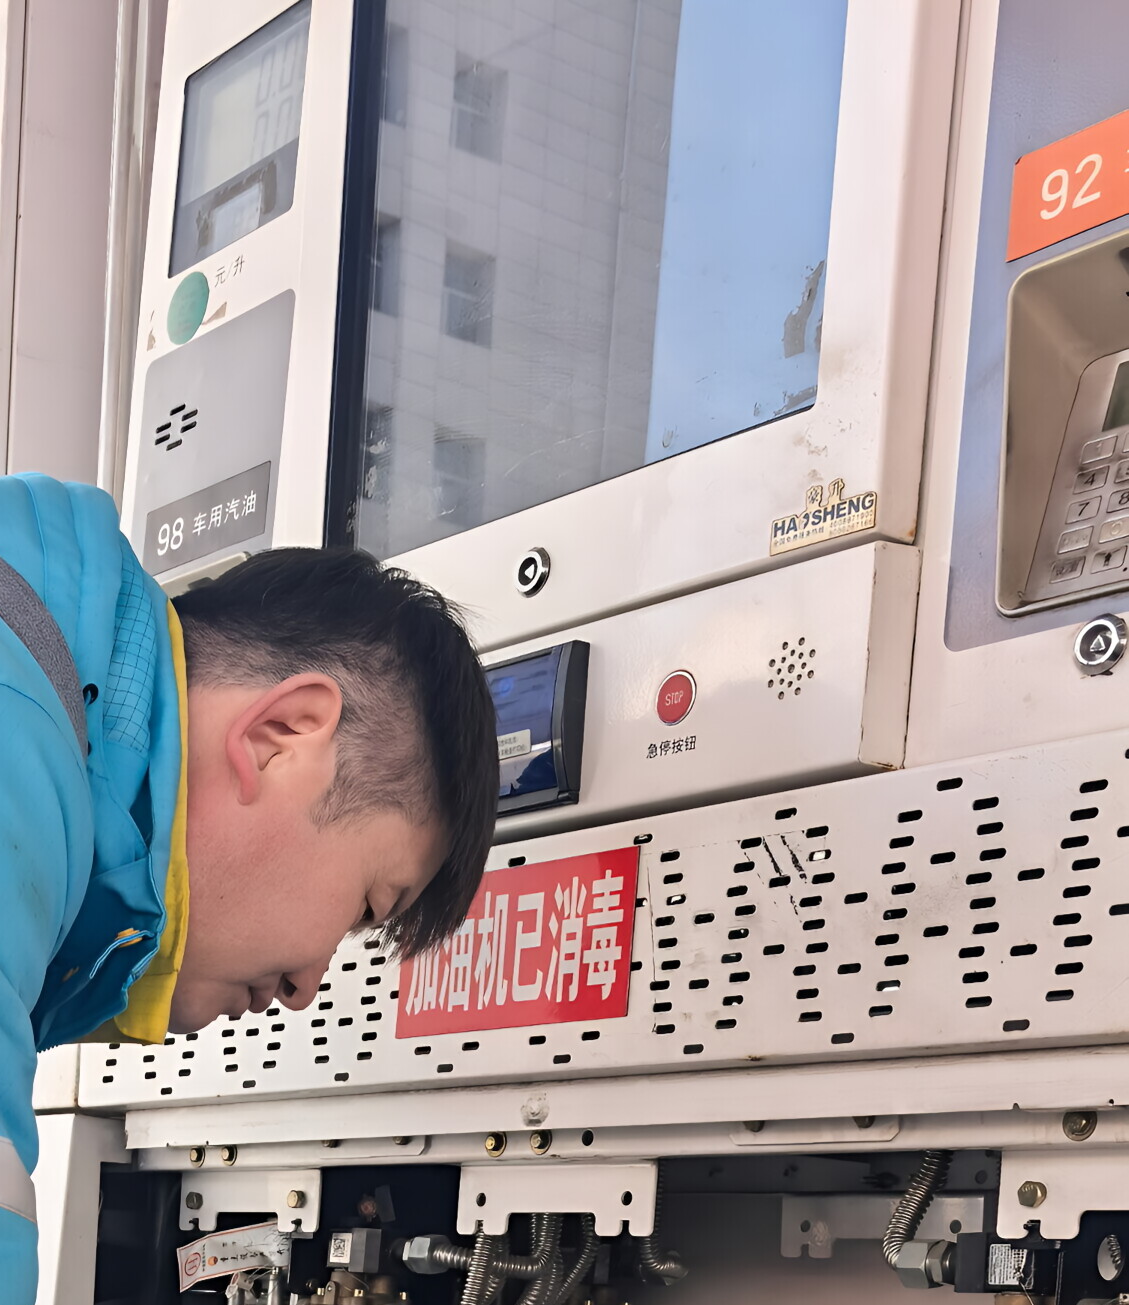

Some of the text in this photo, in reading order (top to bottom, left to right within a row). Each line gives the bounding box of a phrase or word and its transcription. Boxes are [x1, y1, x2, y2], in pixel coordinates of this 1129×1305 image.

[1039, 153, 1103, 220] 92
[214, 255, 246, 288] 元/升
[1084, 472, 1096, 487] 4
[157, 490, 257, 556] 98 车用汽油
[1078, 502, 1090, 517] 7
[665, 690, 684, 706] STOP
[646, 735, 697, 759] 急停按钮
[405, 869, 624, 1016] 加油机已消毒
